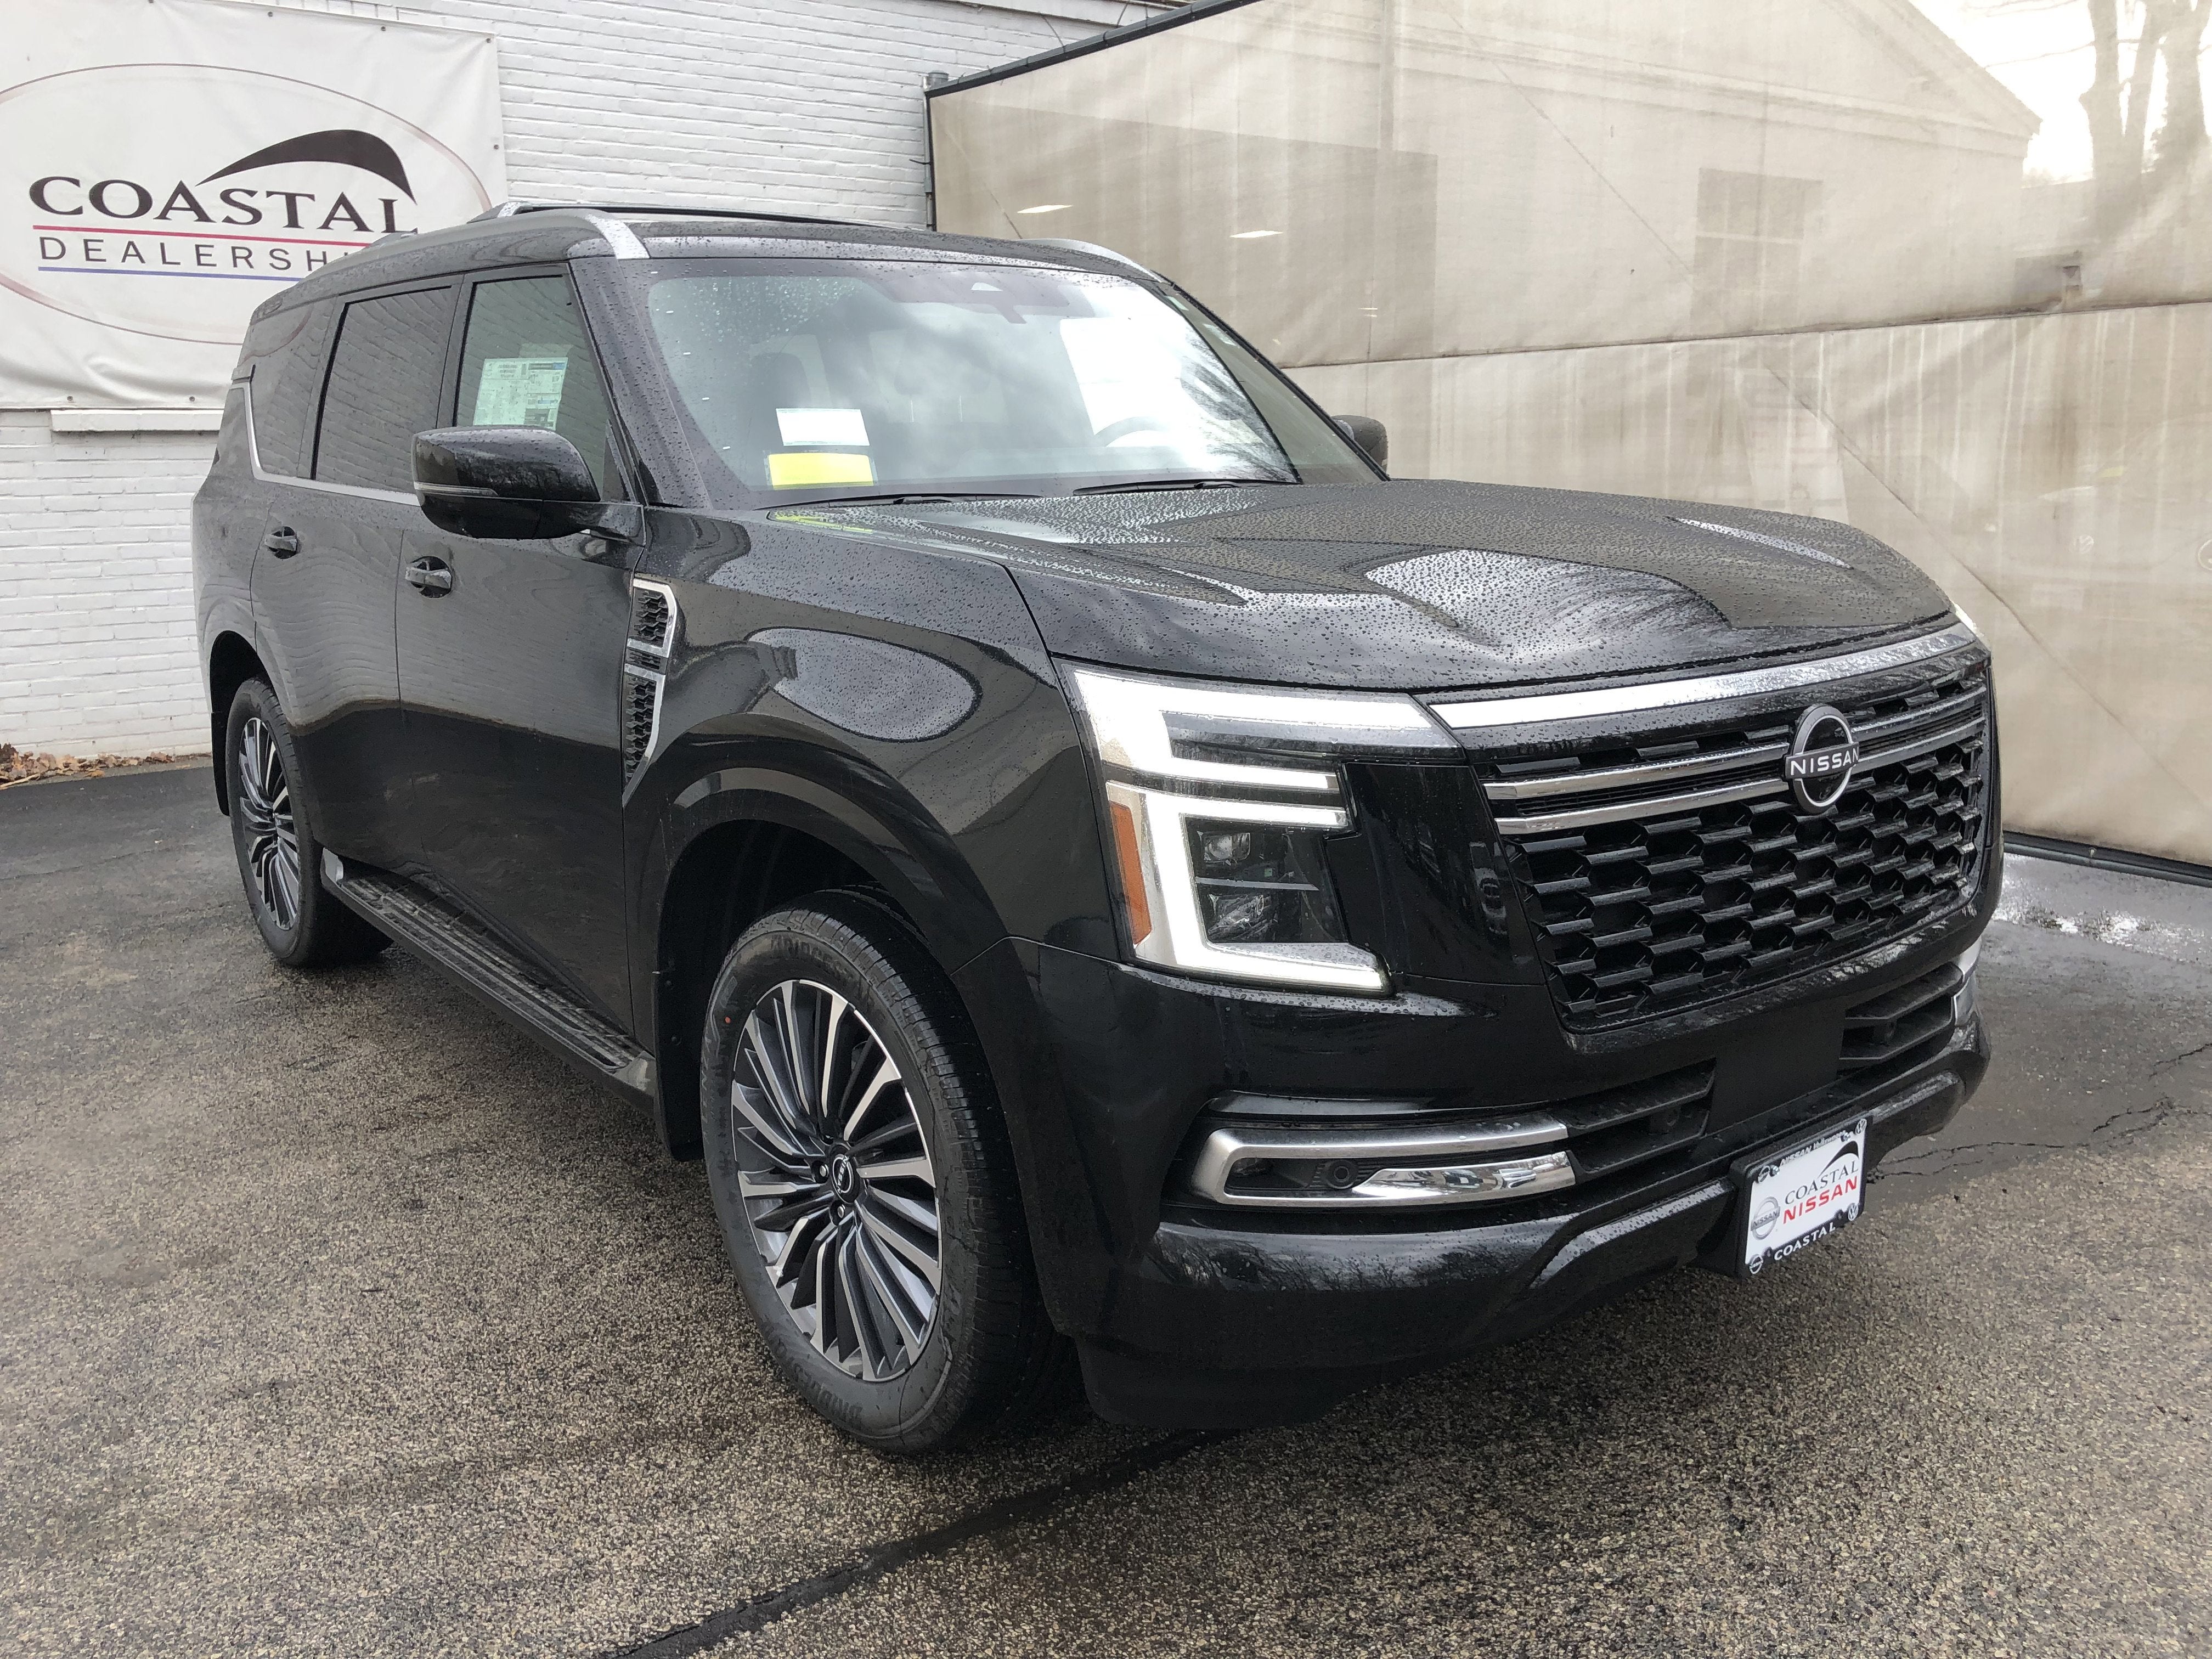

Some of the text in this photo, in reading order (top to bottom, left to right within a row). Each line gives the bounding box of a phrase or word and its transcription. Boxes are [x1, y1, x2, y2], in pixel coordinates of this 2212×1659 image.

[29, 176, 418, 234] COASTAL
[40, 236, 348, 272] DEALERSH
[1791, 746, 1859, 776] NISSAN
[837, 1155, 849, 1194] NISSAN
[1784, 1160, 1859, 1205] COASTAL
[1753, 1210, 1778, 1228] NISSAN
[1783, 1176, 1858, 1224] NISSAN
[1774, 1222, 1836, 1261] COASTAL
